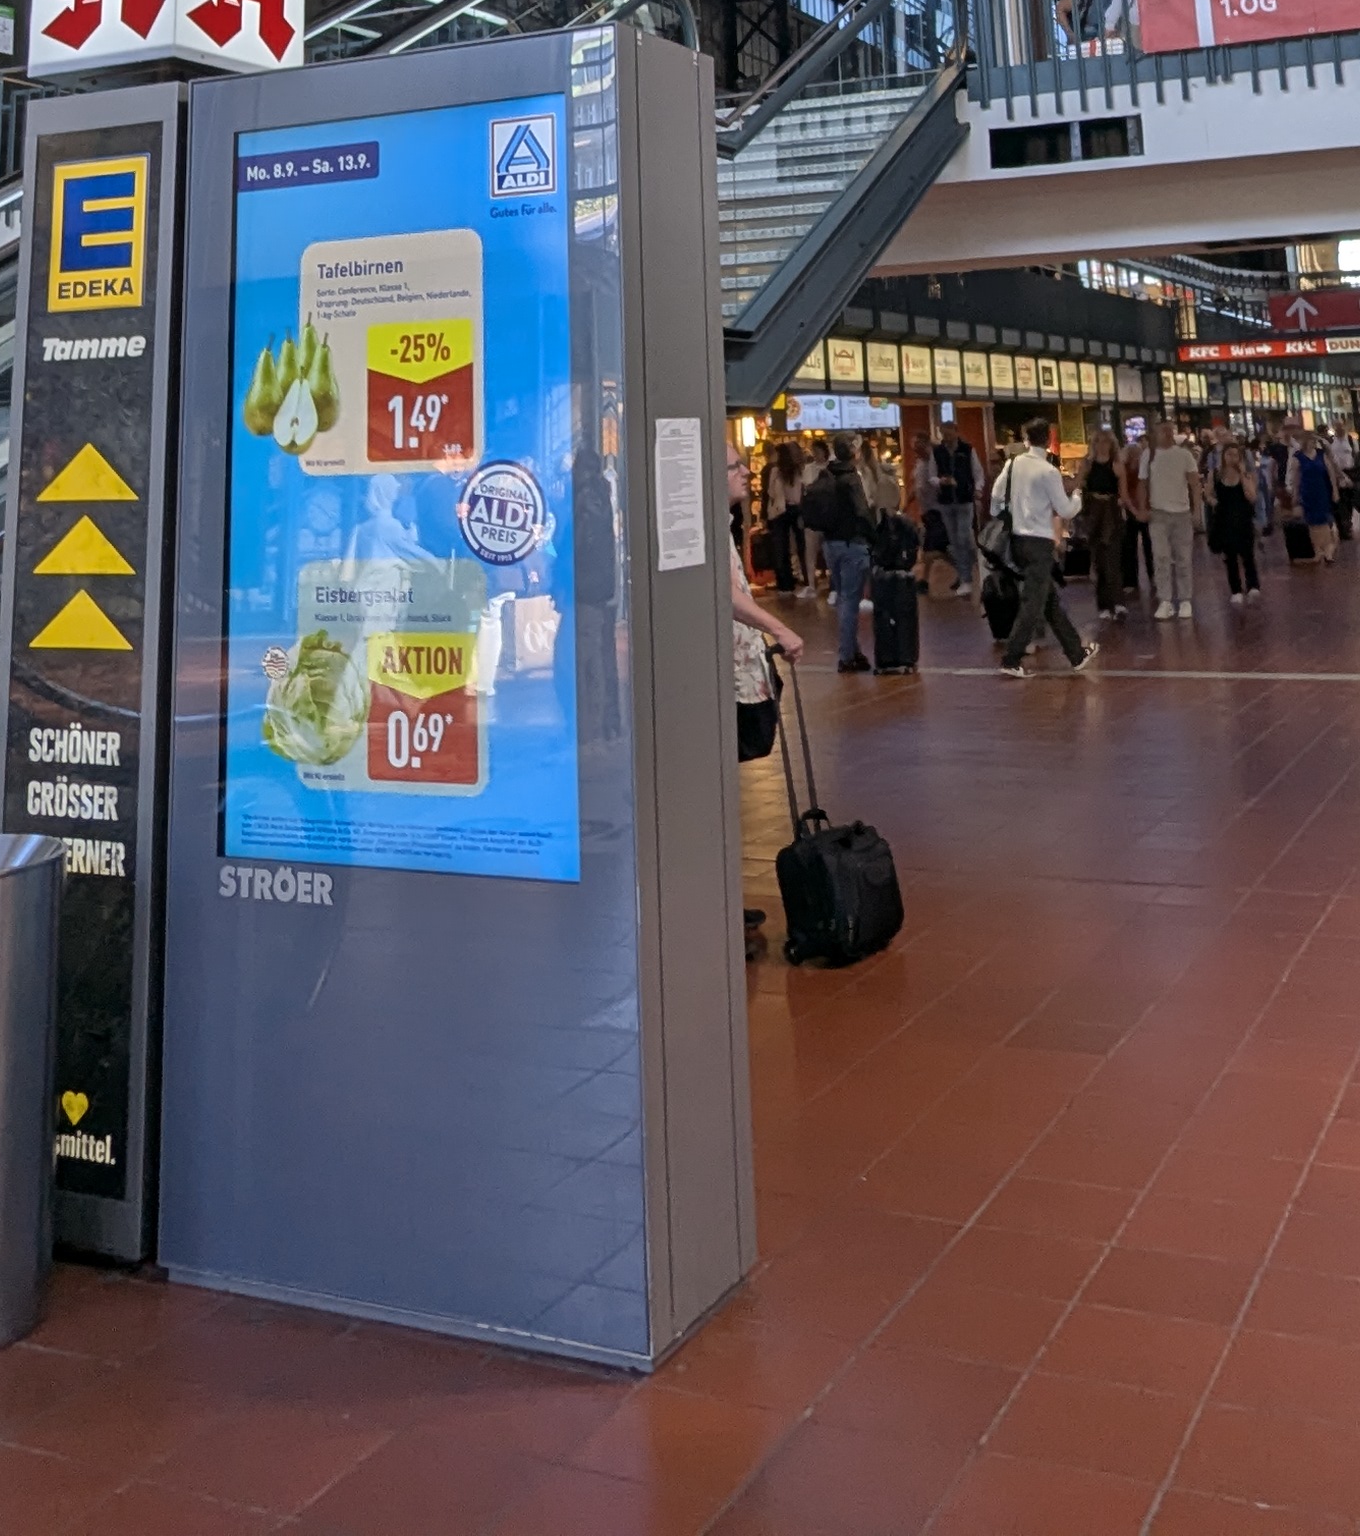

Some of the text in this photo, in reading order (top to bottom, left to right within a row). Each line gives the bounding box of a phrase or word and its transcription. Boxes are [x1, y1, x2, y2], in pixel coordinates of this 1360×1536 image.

[246, 165, 271, 182] Mo.
[273, 161, 299, 179] 8.9.
[312, 158, 334, 175] Sa.
[337, 152, 372, 172] 13.9.
[501, 171, 546, 190] ALDI
[317, 260, 404, 280] Tafelbirnen
[57, 277, 134, 300] EDEKA
[42, 333, 147, 362] Tamme
[390, 332, 451, 364] -25%
[1189, 345, 1220, 358] KFC
[1285, 339, 1318, 354] KFC
[480, 484, 529, 502] ORIGINAL
[470, 496, 535, 530] ALDI
[481, 526, 517, 544] PREIS
[315, 586, 414, 607] Eisbergsalat
[382, 646, 463, 675] AKTION
[28, 722, 121, 767] SCHÖNER
[26, 775, 119, 821] GRÖSSER
[62, 837, 126, 877] ERNER
[219, 864, 334, 906] STRÖER
